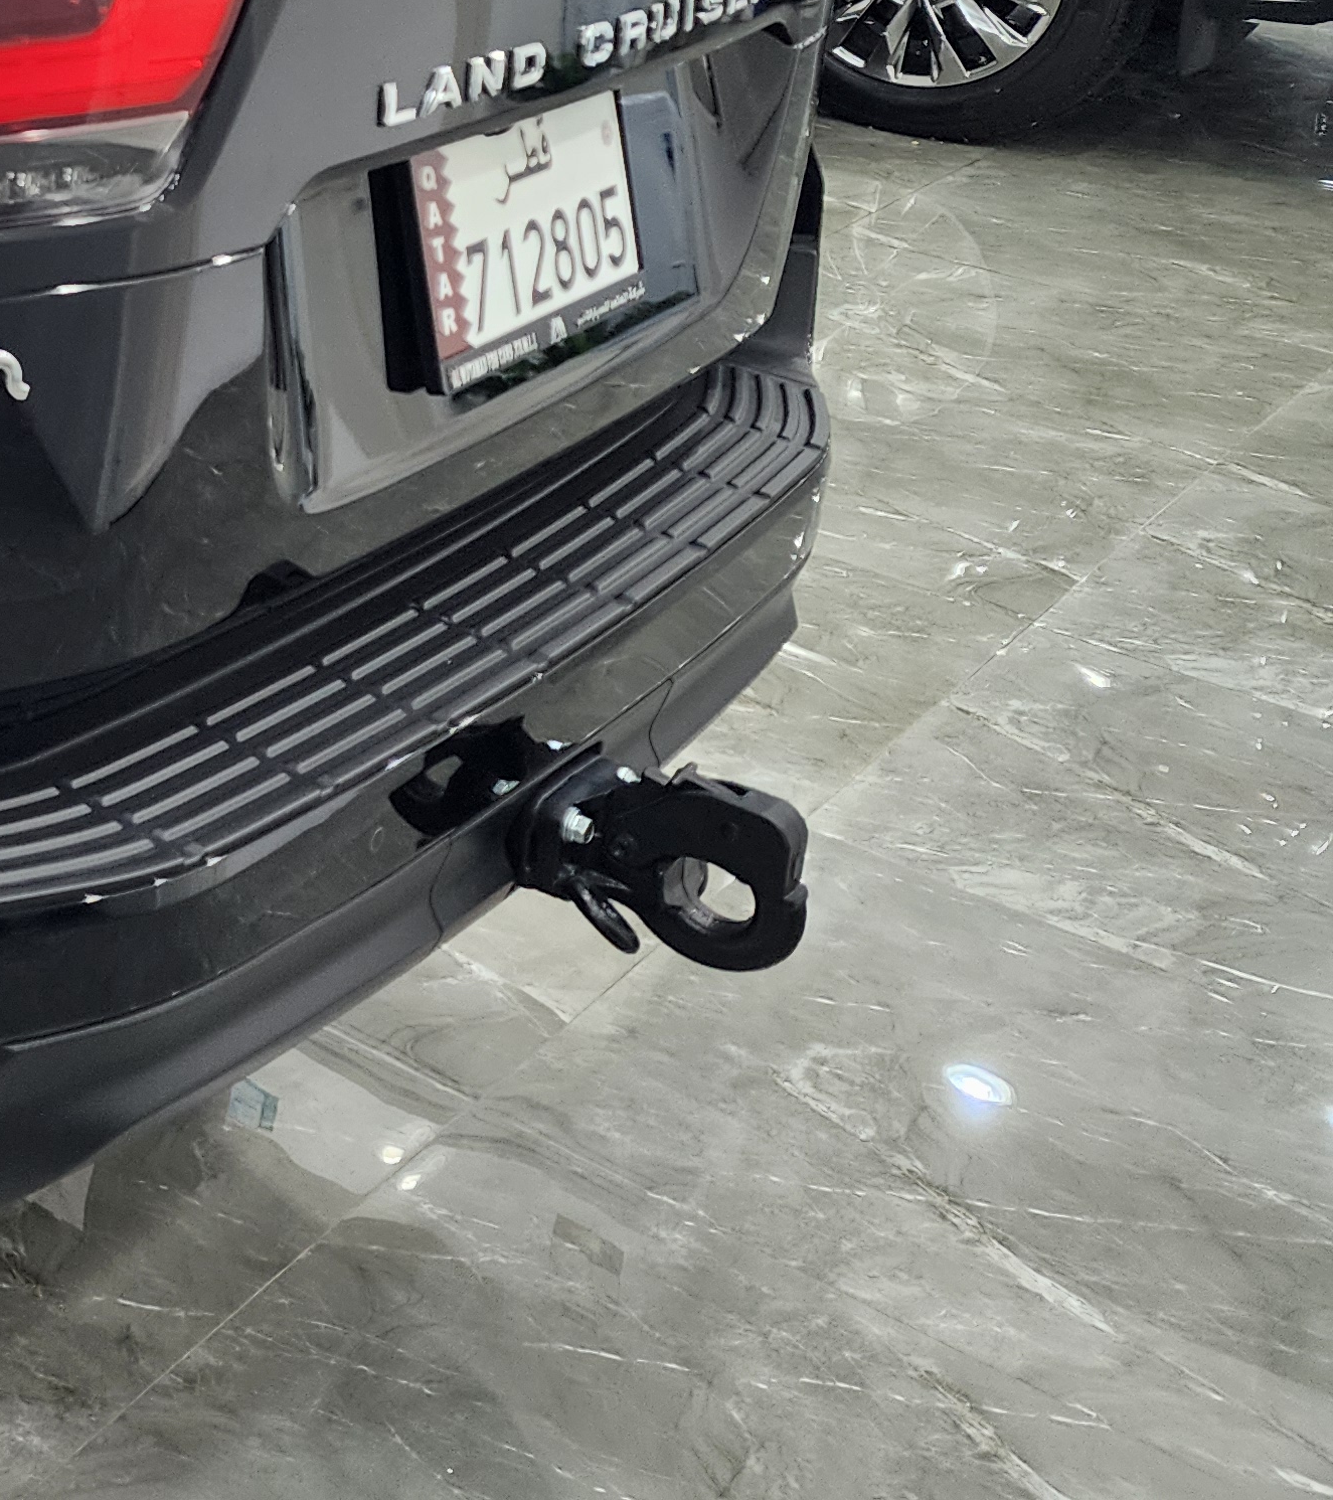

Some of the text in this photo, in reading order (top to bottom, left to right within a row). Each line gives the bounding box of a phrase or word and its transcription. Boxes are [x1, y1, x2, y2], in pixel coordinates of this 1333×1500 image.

[378, 42, 545, 127] LAND
[496, 117, 553, 204] قطر
[420, 165, 457, 337] QATAR
[465, 186, 627, 334] 712805
